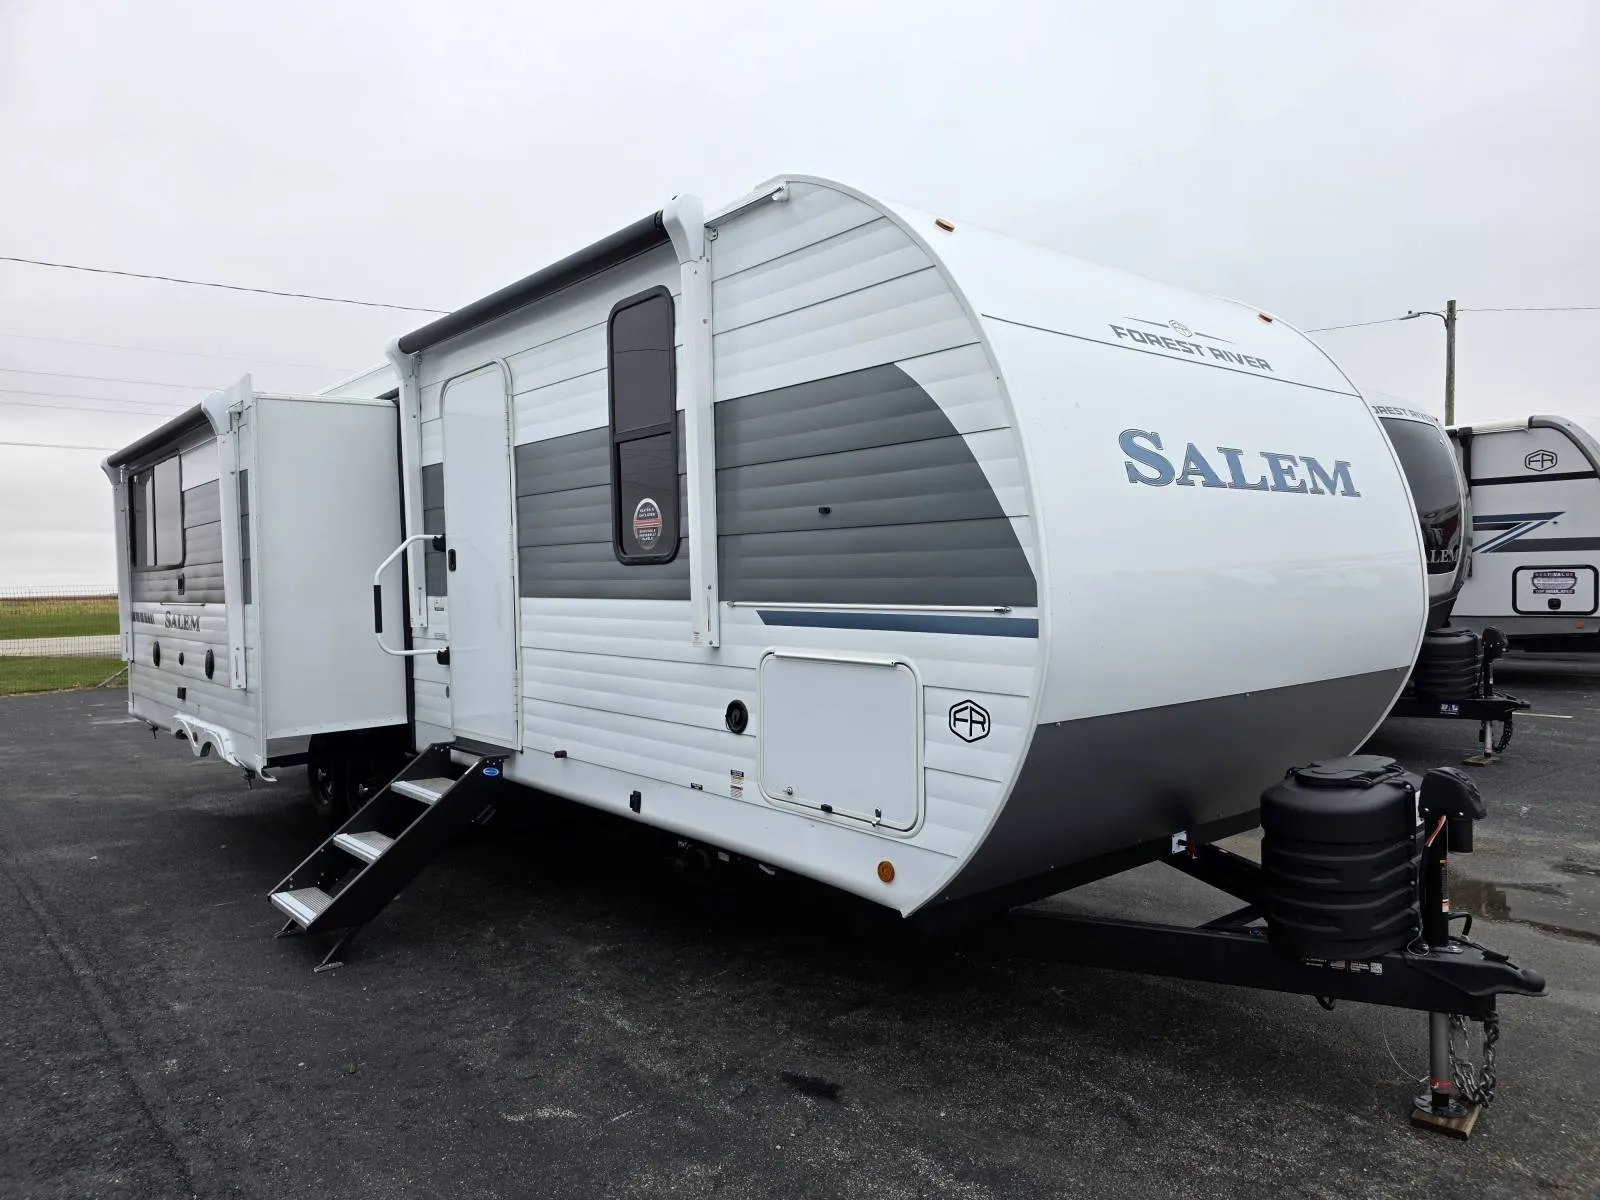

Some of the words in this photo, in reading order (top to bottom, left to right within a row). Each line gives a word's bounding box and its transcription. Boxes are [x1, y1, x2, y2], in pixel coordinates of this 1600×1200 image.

[1108, 324, 1206, 357] FOREST
[1207, 346, 1275, 372] RIVER
[1118, 428, 1361, 498] SALEM
[165, 611, 200, 632] SALEM
